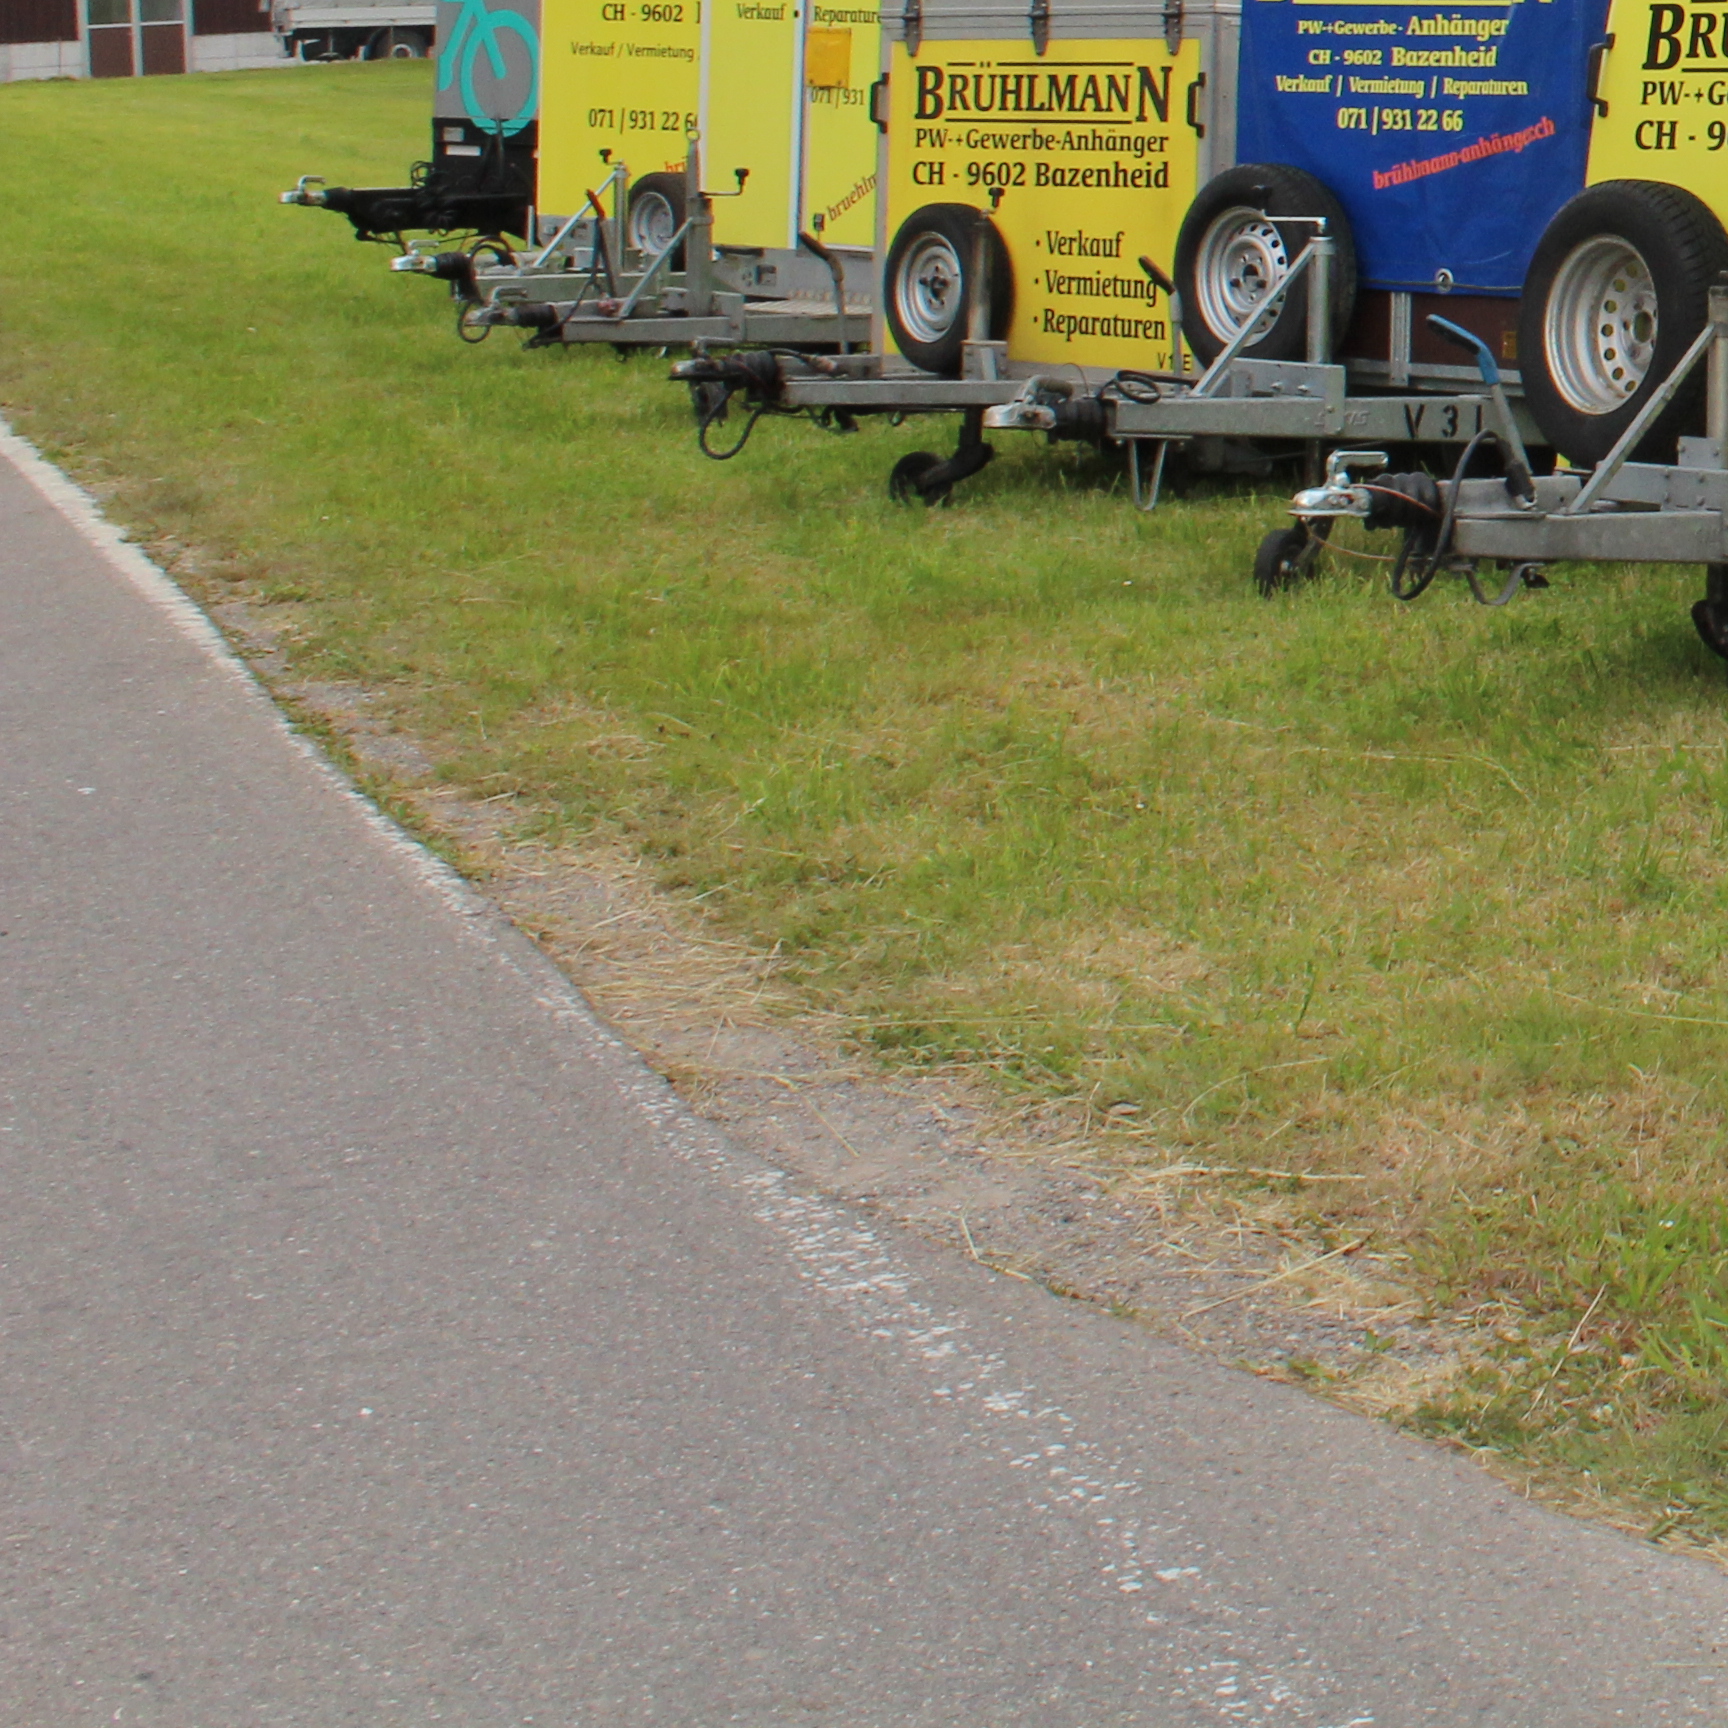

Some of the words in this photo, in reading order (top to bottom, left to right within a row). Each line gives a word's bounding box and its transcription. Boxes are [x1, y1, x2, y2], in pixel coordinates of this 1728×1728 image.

[602, 3, 626, 21] CH
[641, 4, 683, 22] 9602
[737, 3, 787, 20] Verkauf
[1407, 15, 1510, 41] Anhänger
[571, 42, 615, 56] Verkauf
[626, 43, 694, 62] Vermietung
[1308, 50, 1331, 65] CH
[1344, 50, 1382, 65] 9602
[1391, 46, 1498, 67] Bazenheid
[810, 86, 831, 104] 071
[842, 89, 865, 105] 931
[914, 61, 1173, 122] BRÜHLMANN
[1275, 75, 1333, 93] Verkauf
[1349, 76, 1425, 98] Vermietung
[1443, 78, 1528, 99] Reparaturen
[588, 108, 614, 128] 071
[629, 110, 656, 130] 931
[661, 111, 679, 131] 22
[1337, 108, 1368, 129] 071
[1382, 109, 1412, 130] 931
[1417, 110, 1438, 131] 22
[1442, 111, 1464, 132] 66
[1634, 120, 1678, 150] CH
[913, 161, 945, 186] CH
[967, 162, 1026, 186] 9602
[1035, 162, 1170, 188] Bazenheid
[1045, 230, 1124, 258] Verkauf
[1045, 270, 1158, 307] Vermietung
[1043, 308, 1167, 341] Reparaturen
